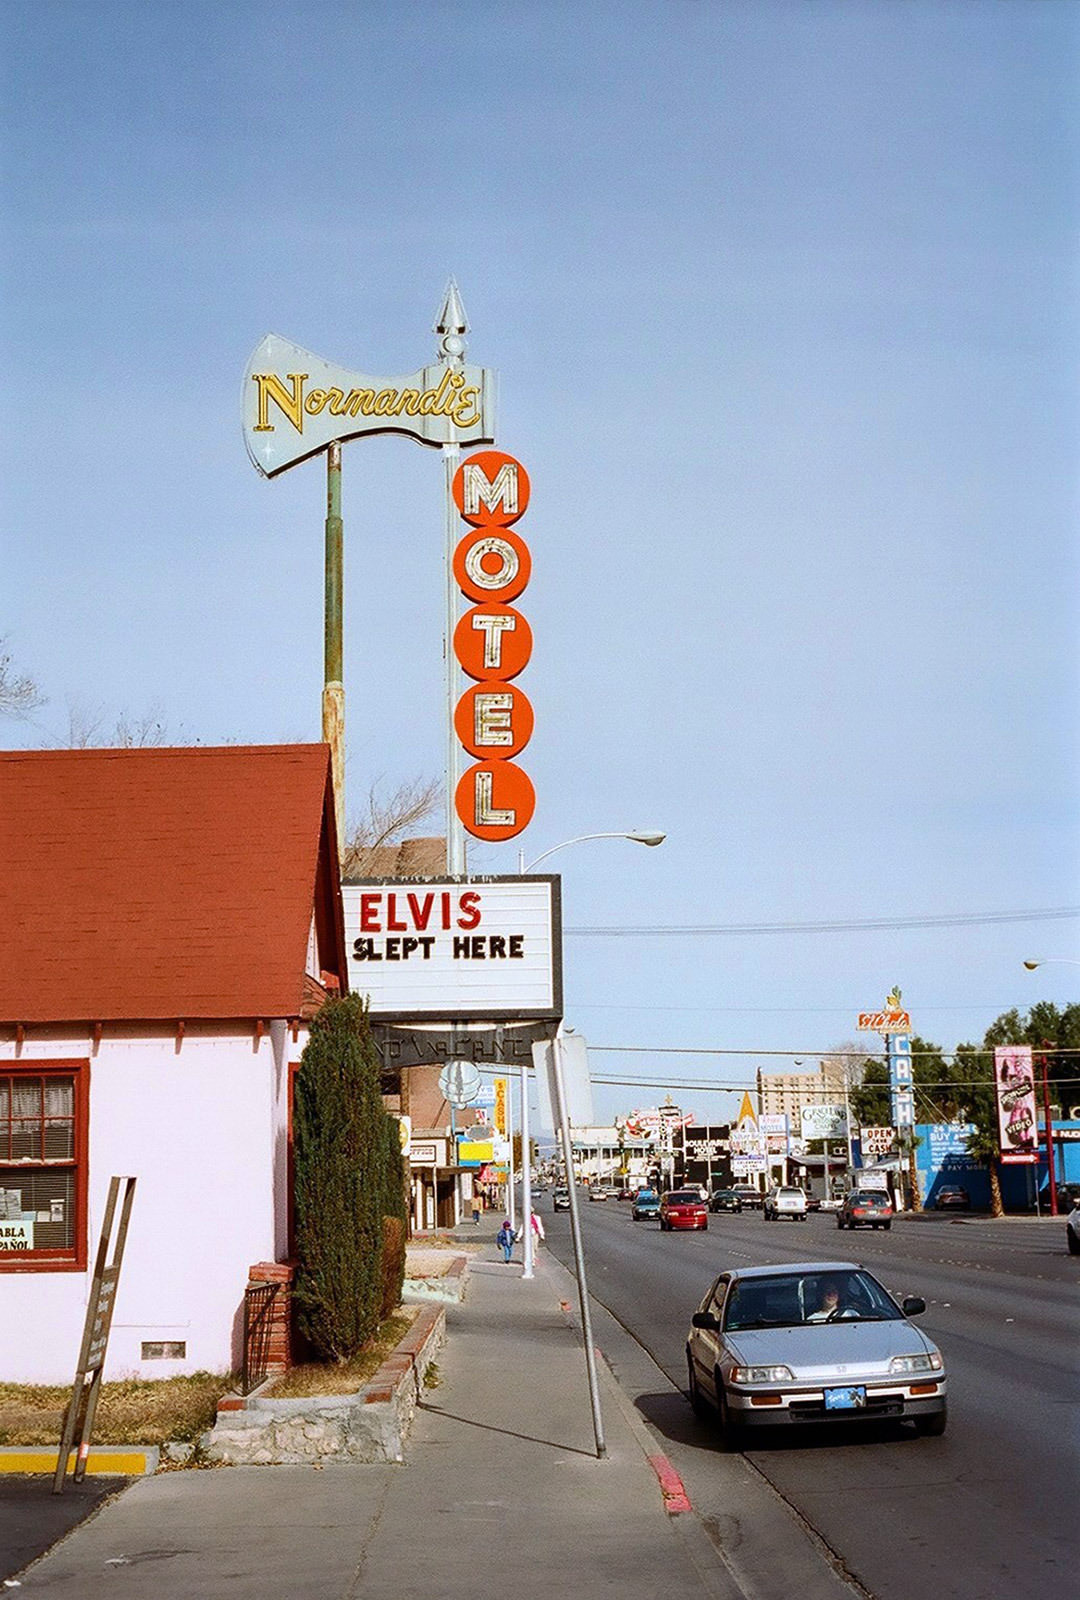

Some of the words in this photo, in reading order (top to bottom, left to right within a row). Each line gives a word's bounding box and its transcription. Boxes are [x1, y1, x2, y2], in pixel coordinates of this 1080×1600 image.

[252, 369, 481, 432] Normandie
[463, 462, 519, 827] MOTEL
[360, 891, 483, 933] ELVIS
[352, 935, 436, 961] SLEPT
[453, 934, 525, 960] HERE
[868, 1129, 892, 1139] OPEN
[930, 1132, 950, 1141] BUY
[868, 1144, 892, 1153] CASH
